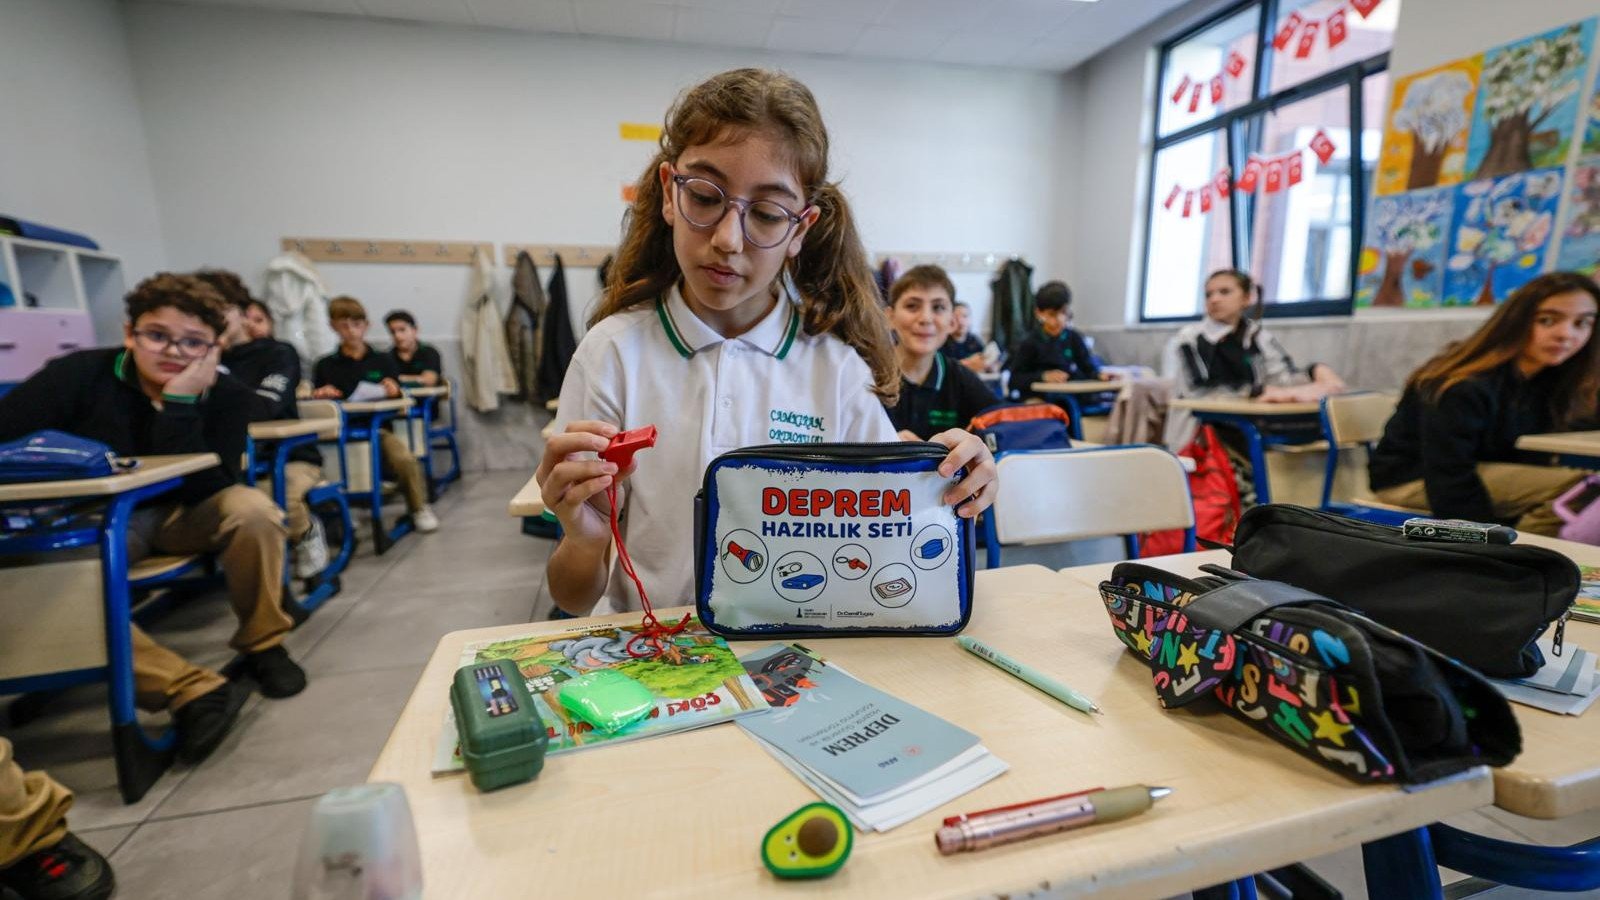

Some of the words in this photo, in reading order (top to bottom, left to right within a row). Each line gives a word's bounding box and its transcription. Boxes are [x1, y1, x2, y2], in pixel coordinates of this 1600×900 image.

[762, 487, 911, 517] DEPREM
[762, 521, 861, 538] HAZIRLIK
[868, 516, 912, 537] SETİ
[822, 713, 901, 756] DEPREM
